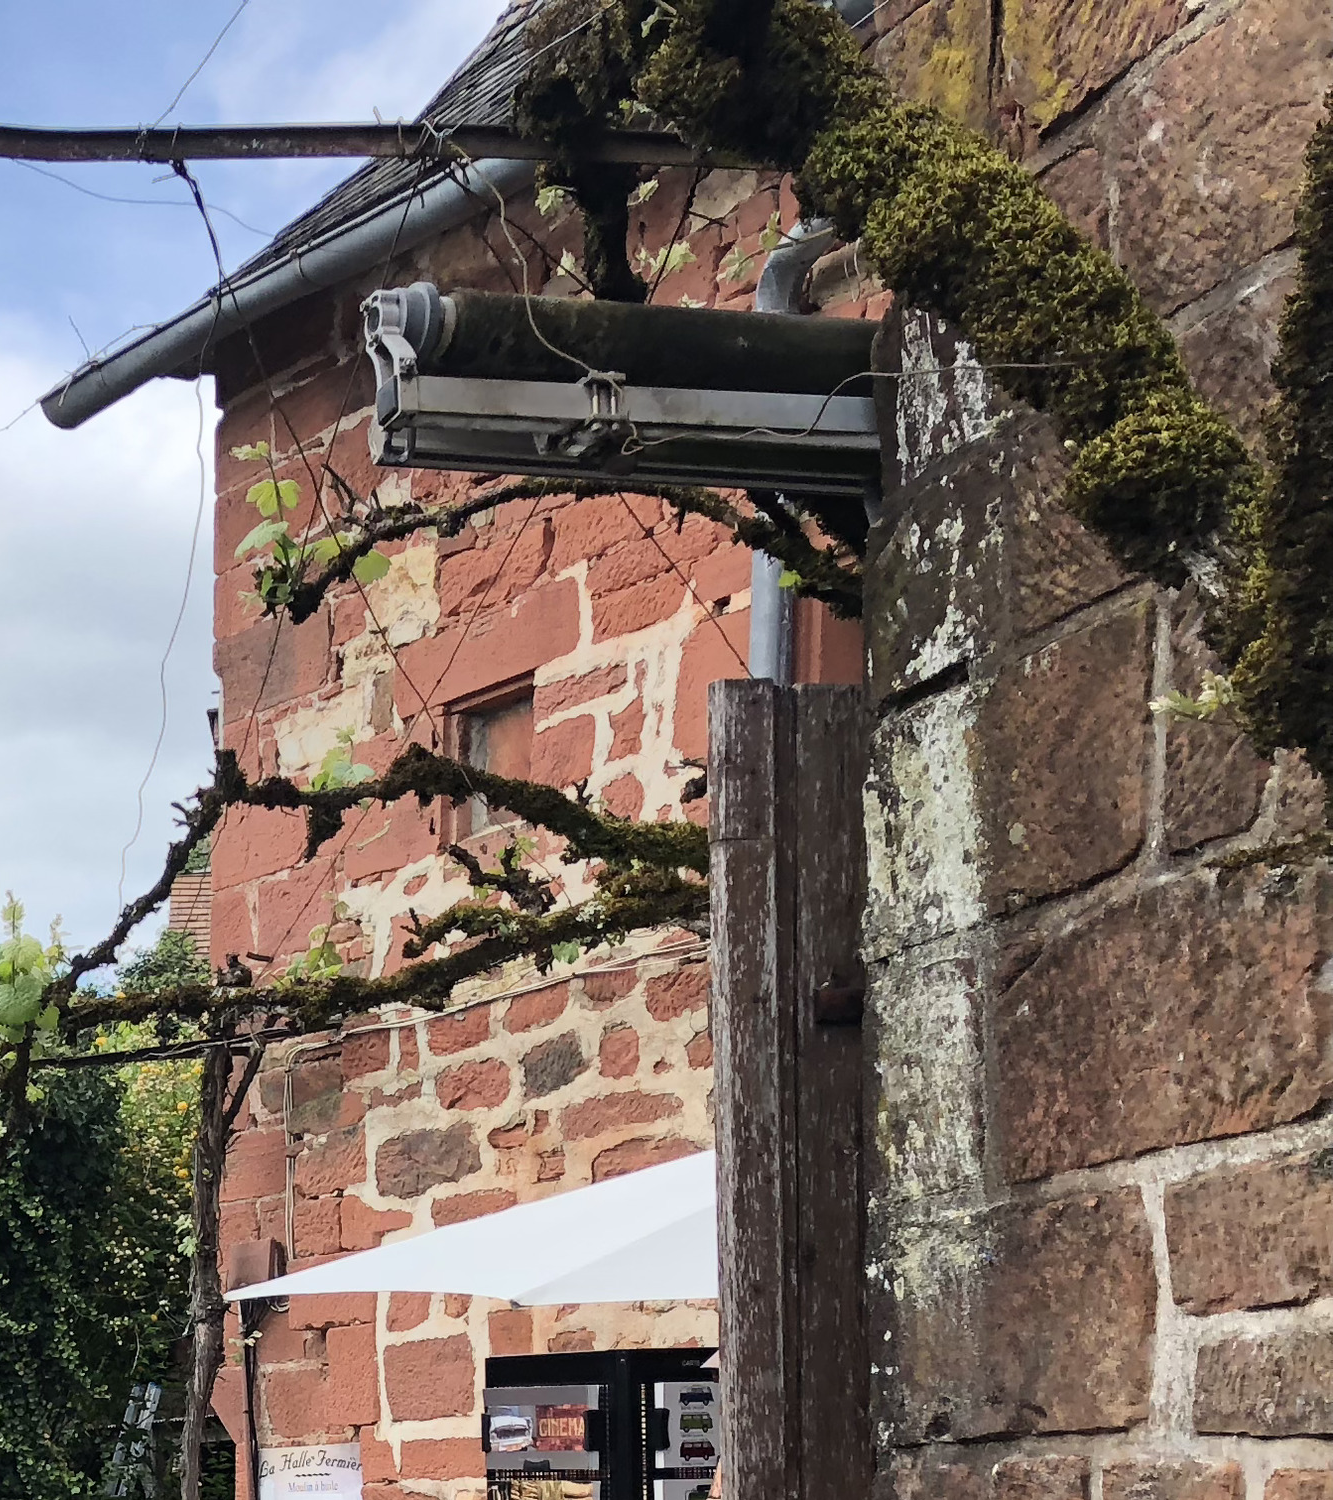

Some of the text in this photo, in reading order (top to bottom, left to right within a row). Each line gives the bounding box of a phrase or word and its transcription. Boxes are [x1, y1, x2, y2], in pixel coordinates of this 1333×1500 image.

[539, 1416, 585, 1438] CINEMA
[259, 1460, 276, 1479] La
[280, 1450, 312, 1472] Halle
[288, 1481, 313, 1493] Moulin
